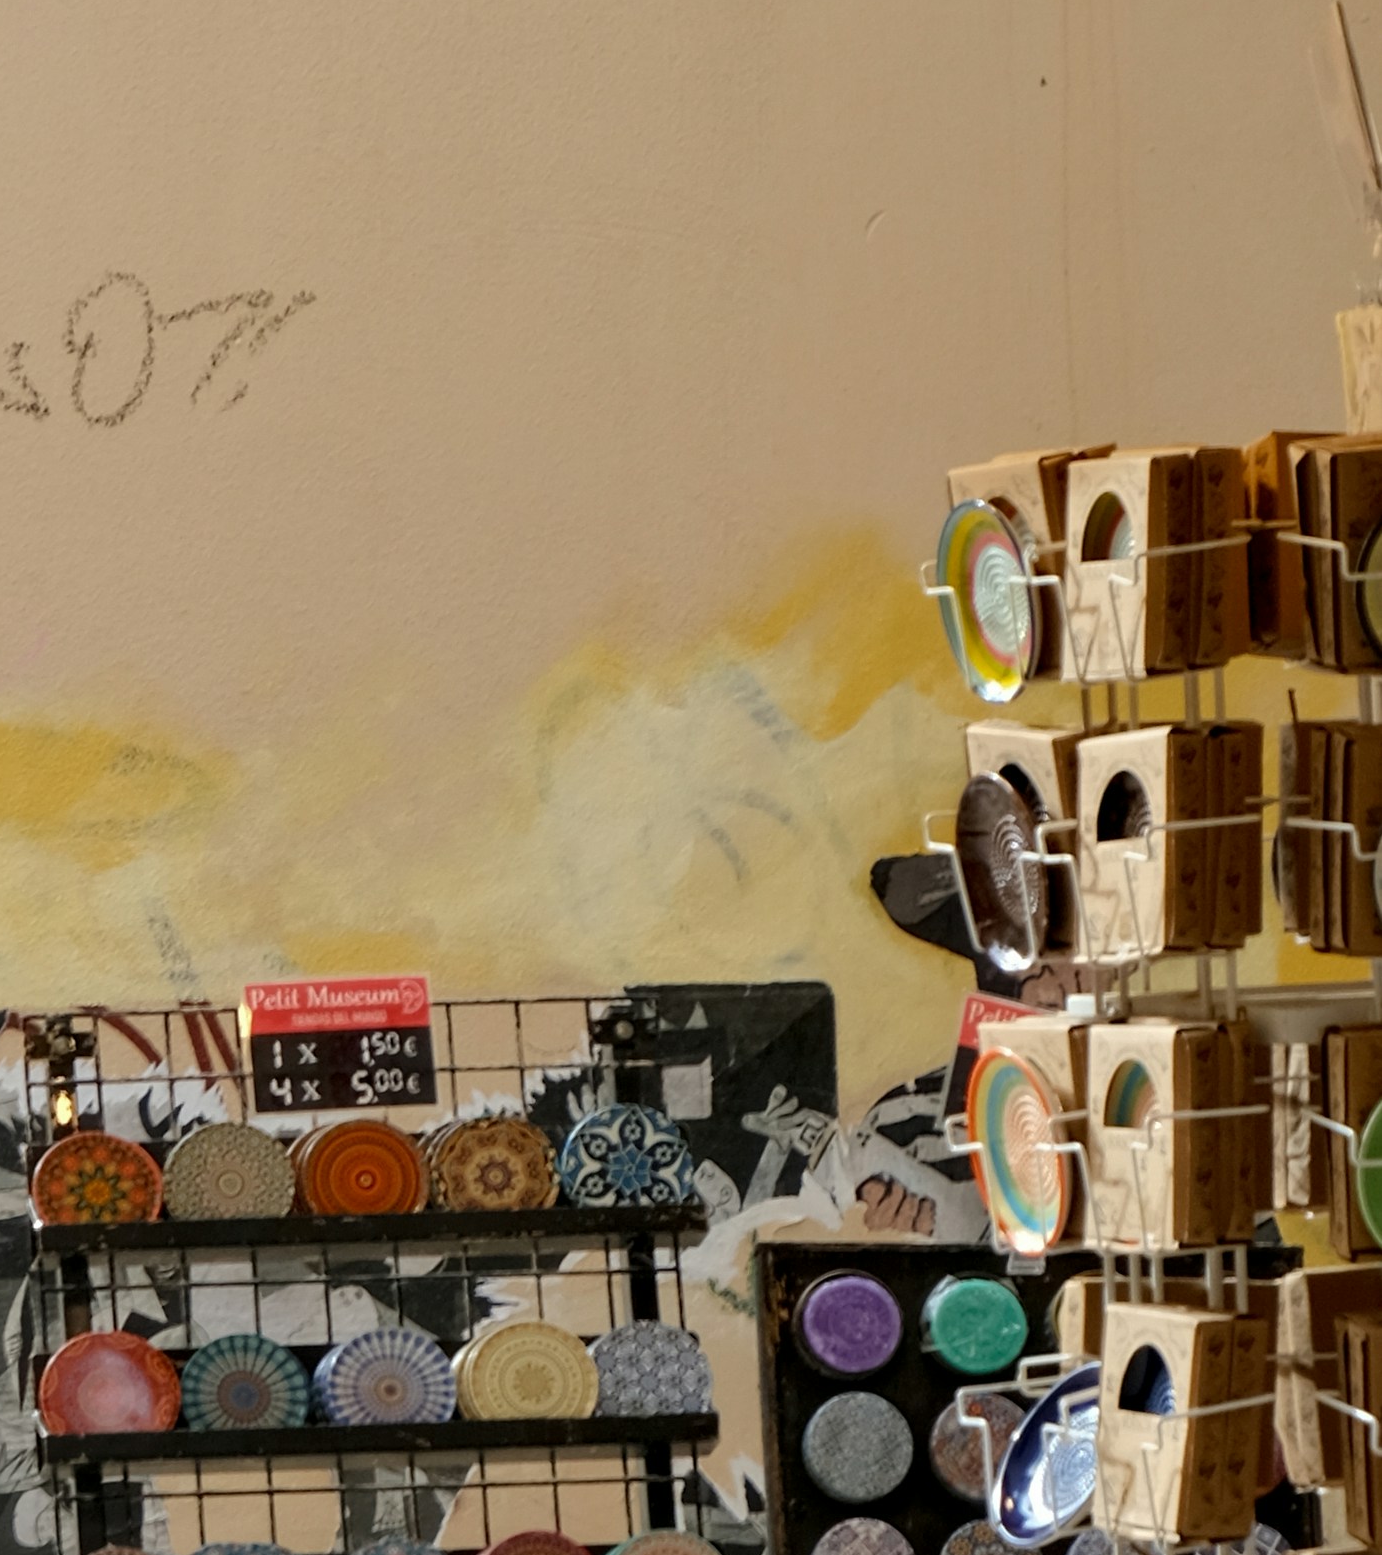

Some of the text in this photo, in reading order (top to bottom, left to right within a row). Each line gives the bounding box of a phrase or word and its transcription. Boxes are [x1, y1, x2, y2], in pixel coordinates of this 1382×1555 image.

[249, 984, 400, 1011] Petit Museum
[272, 1039, 283, 1070] 1
[269, 1076, 293, 1106] 4
